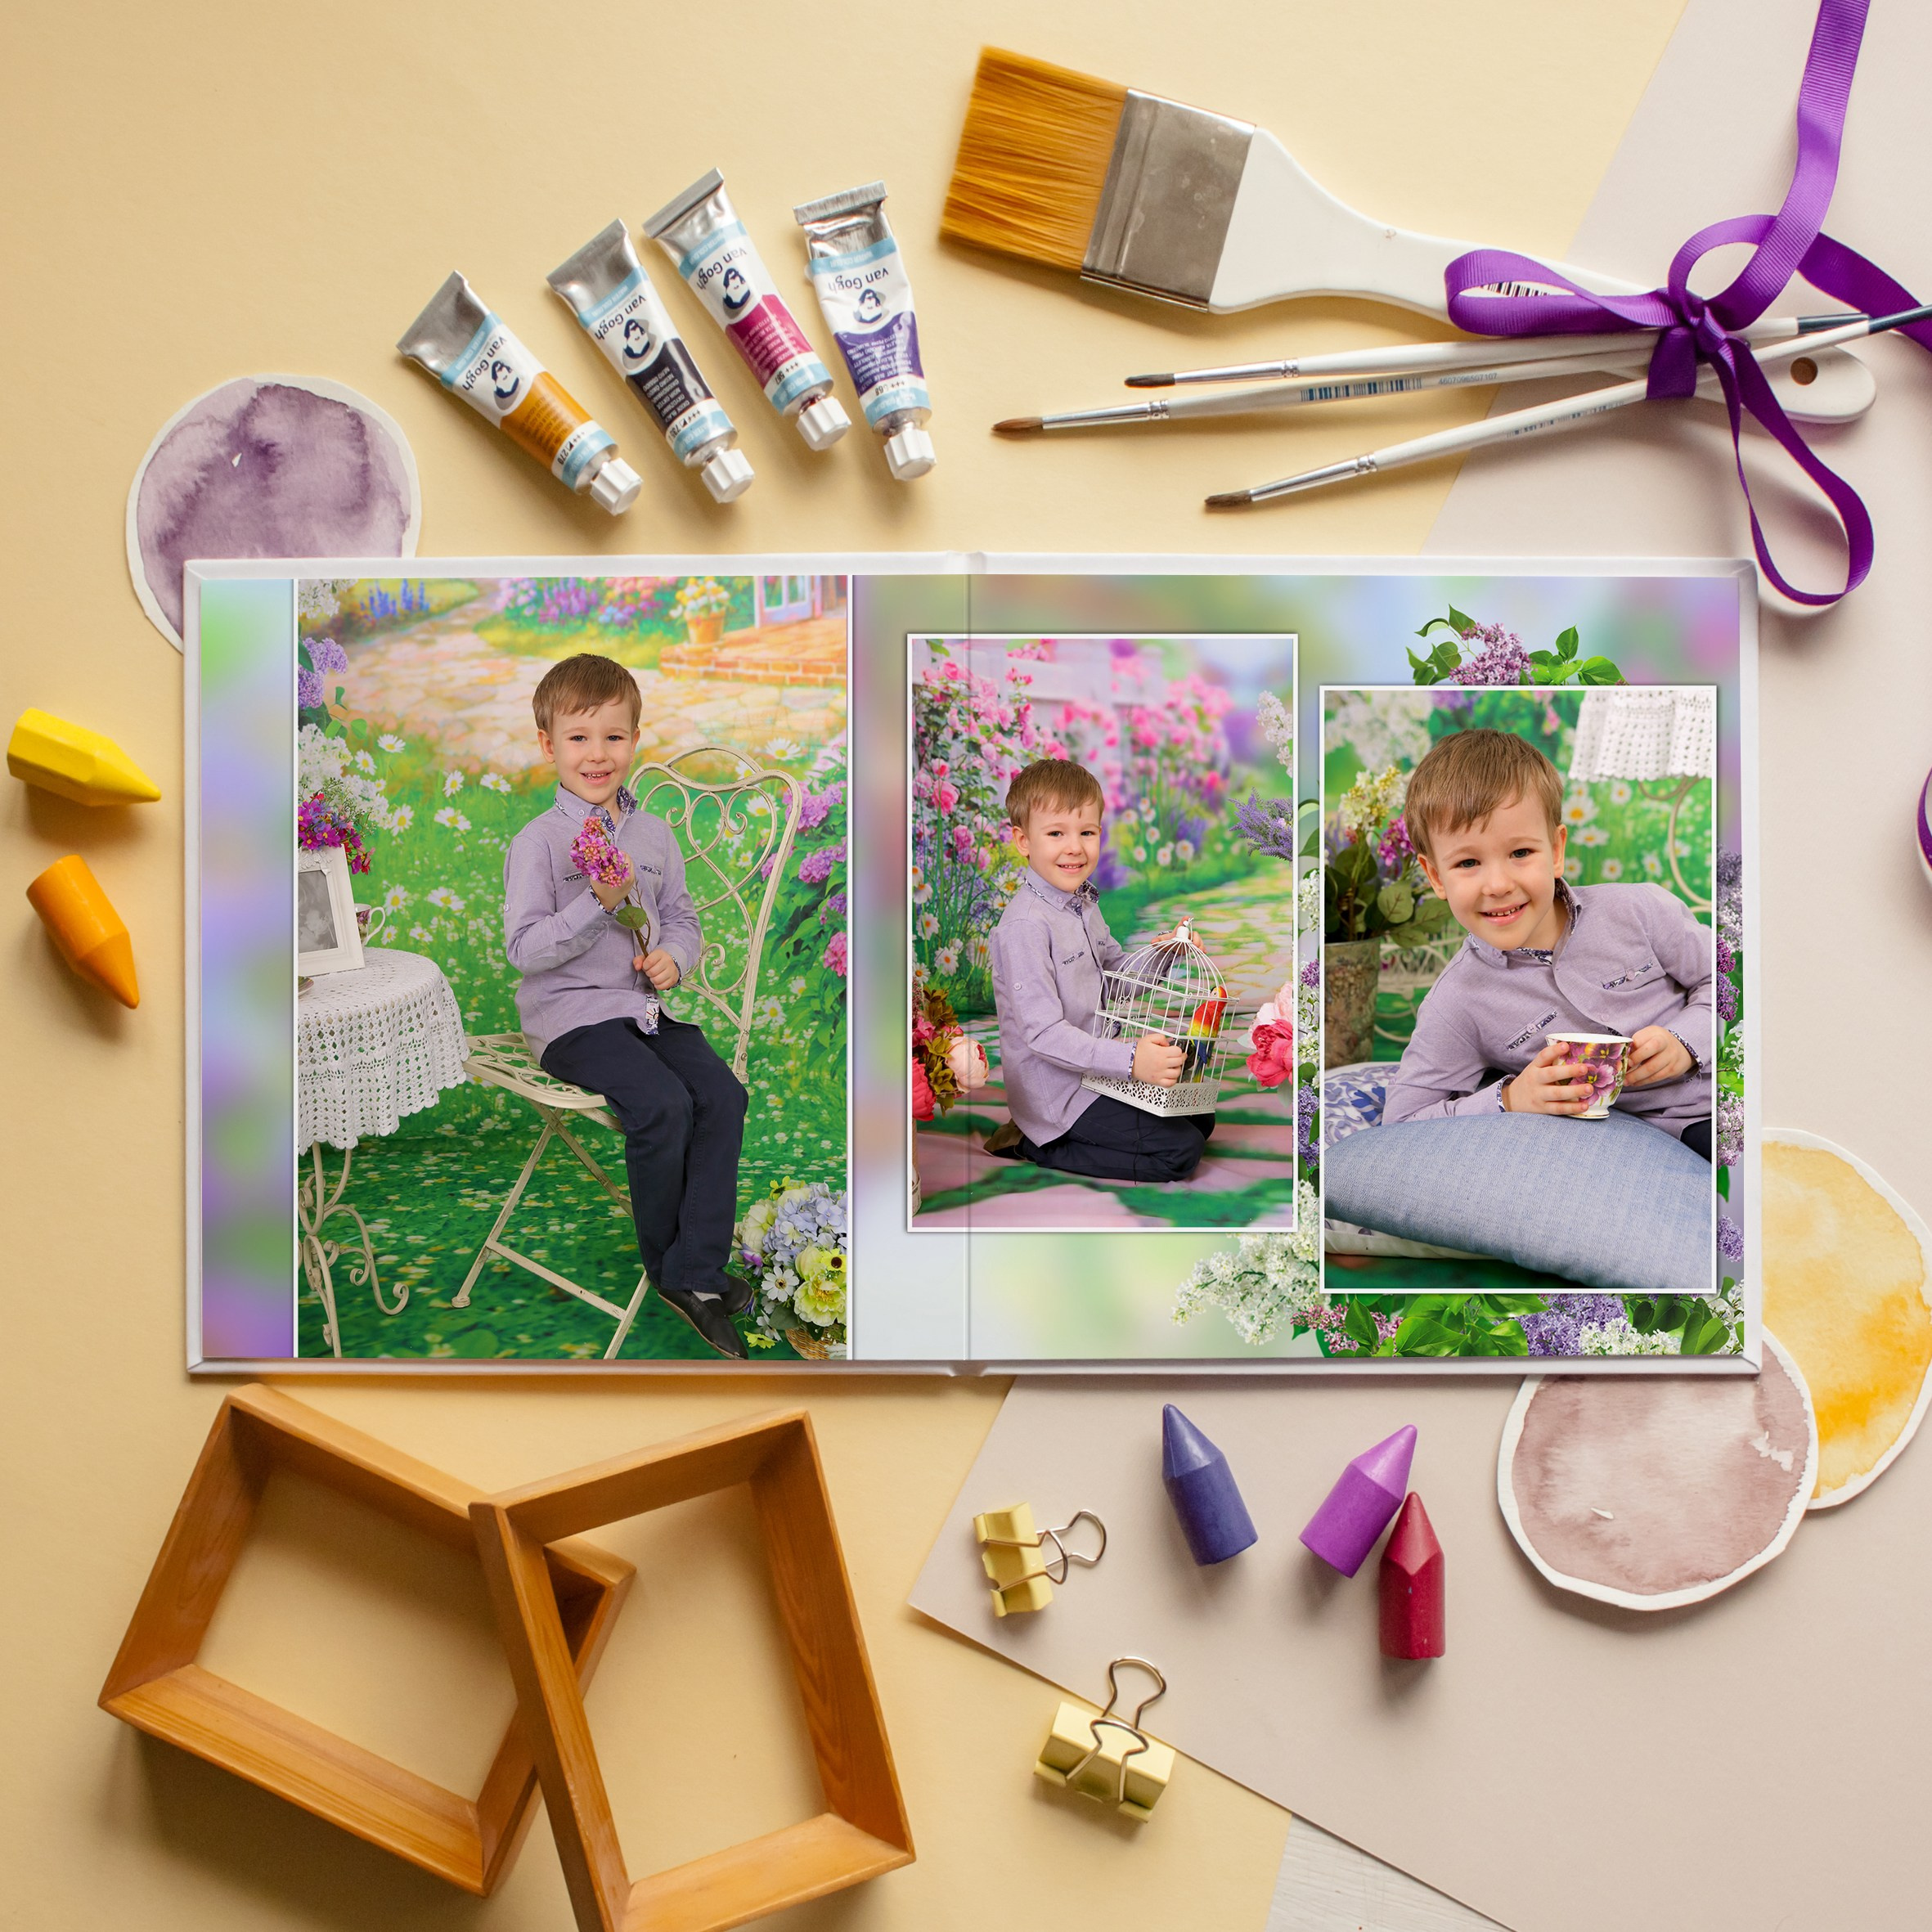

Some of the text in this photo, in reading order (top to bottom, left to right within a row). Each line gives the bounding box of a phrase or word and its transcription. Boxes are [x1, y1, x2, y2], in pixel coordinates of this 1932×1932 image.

[696, 246, 747, 290] van Gogh
[827, 267, 888, 294] van Gogh
[594, 294, 646, 339] van Gogh
[485, 335, 506, 359] van
[461, 360, 488, 390] Gogh
